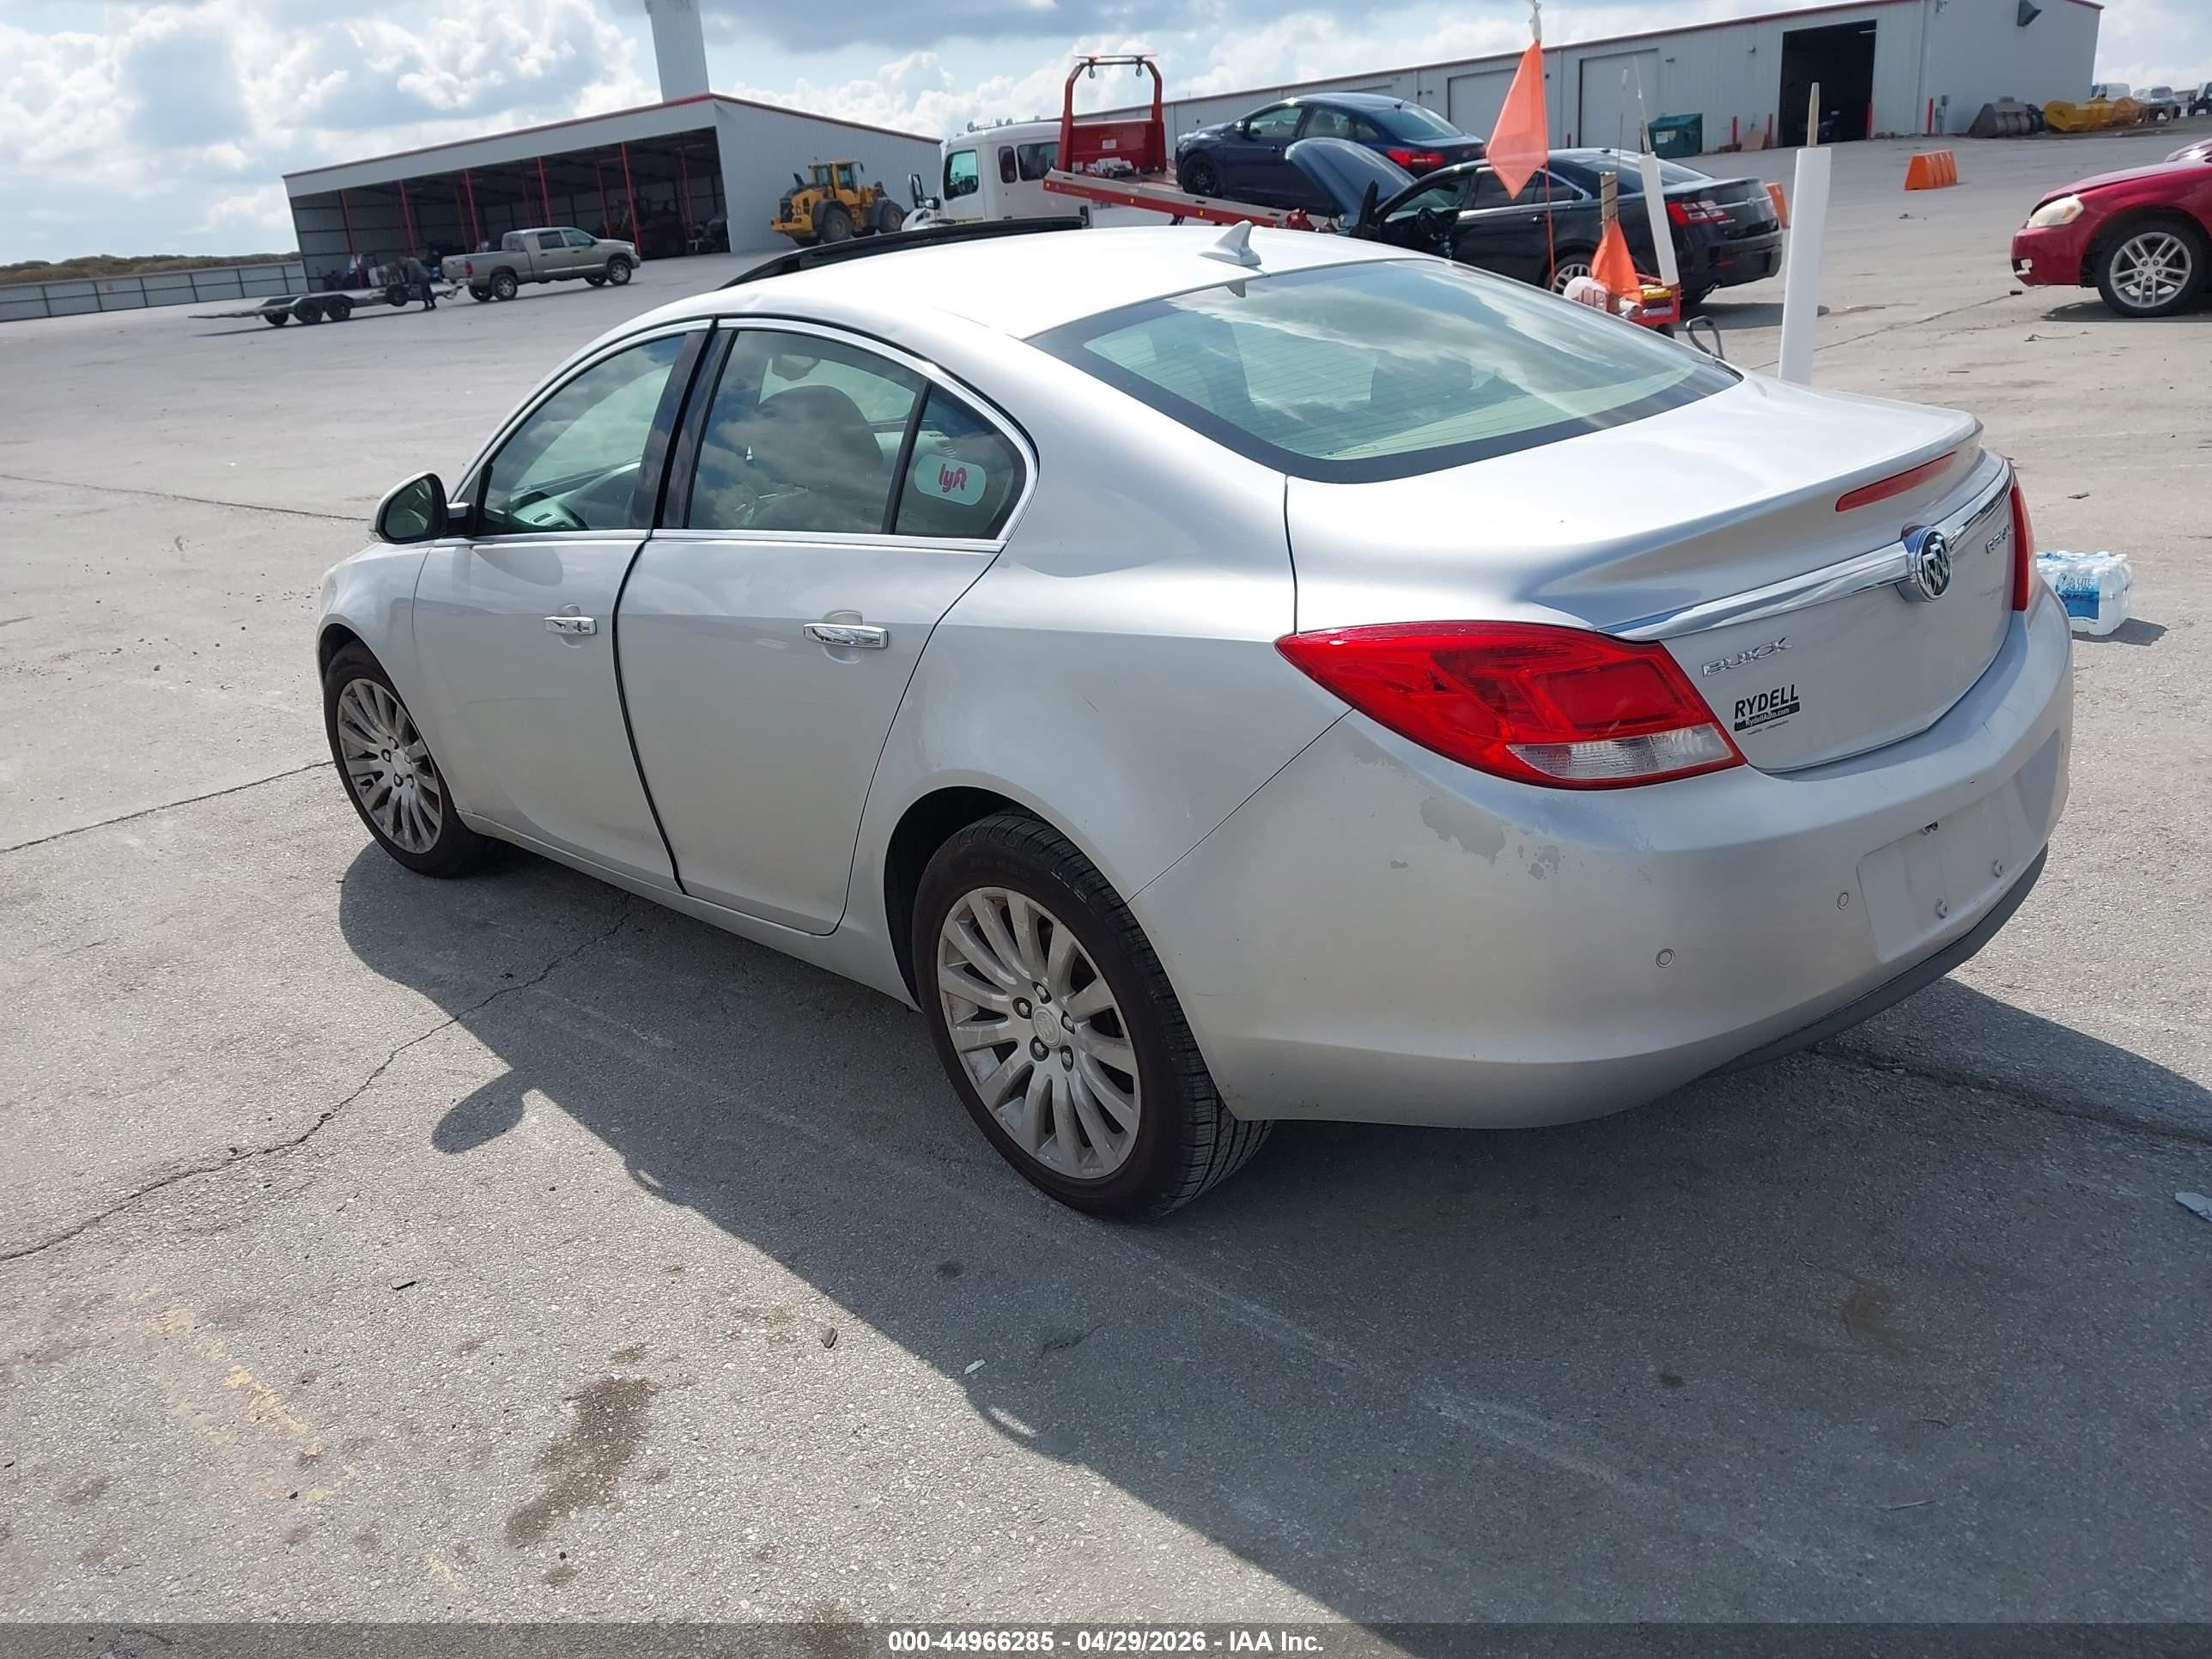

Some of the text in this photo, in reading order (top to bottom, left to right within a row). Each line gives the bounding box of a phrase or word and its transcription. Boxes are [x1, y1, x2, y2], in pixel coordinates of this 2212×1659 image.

[938, 464, 967, 493] lyft
[1702, 636, 1792, 678] BUICK
[1735, 684, 1800, 720] RYDELL
[1745, 708, 1790, 727] RydellAuto.com
